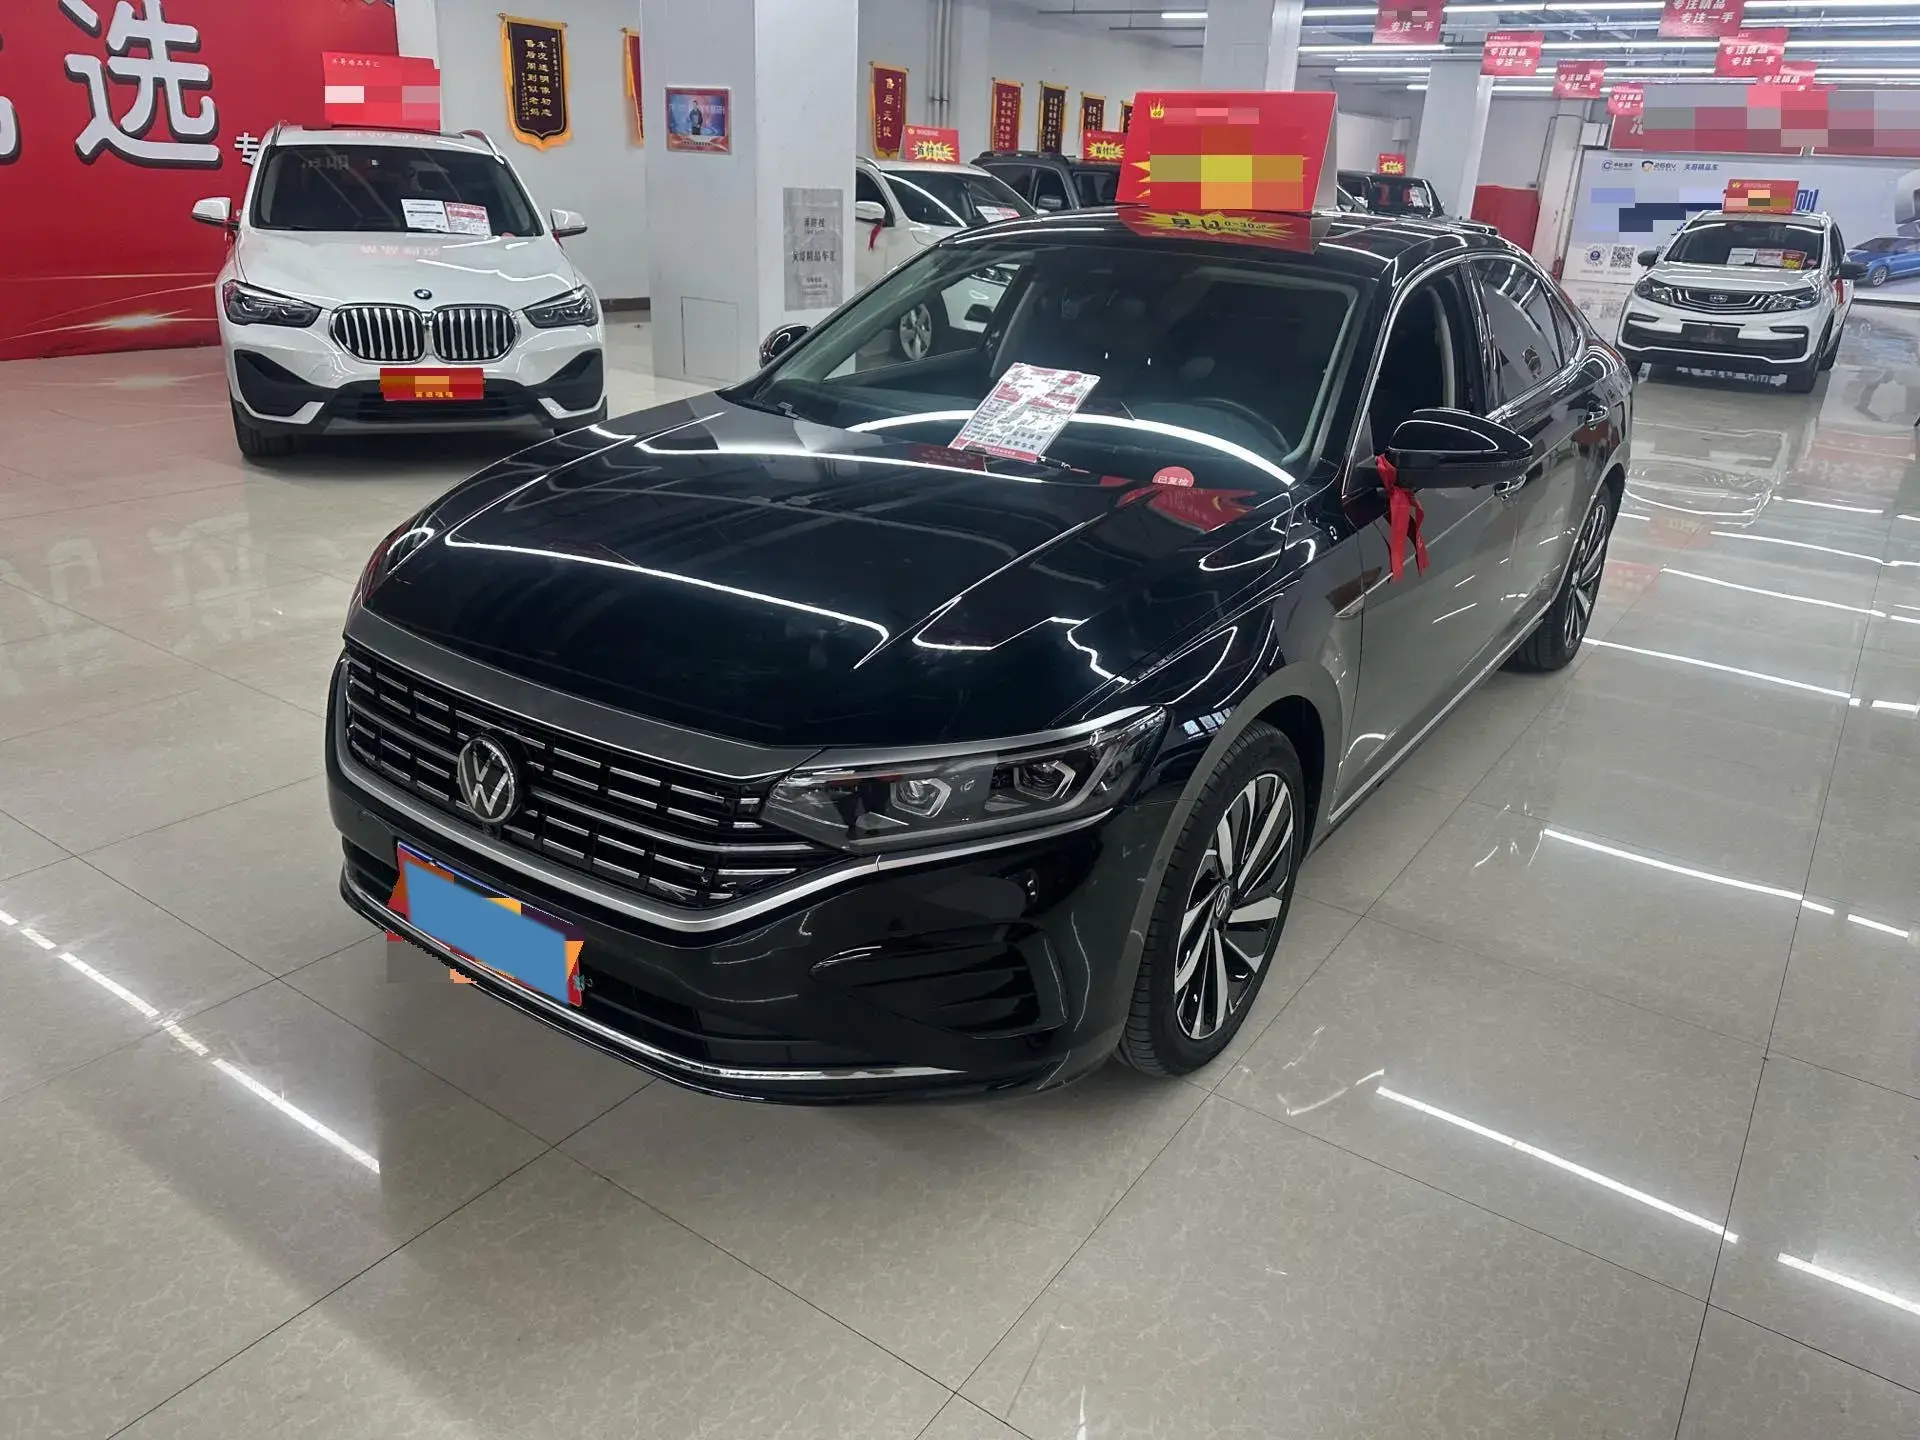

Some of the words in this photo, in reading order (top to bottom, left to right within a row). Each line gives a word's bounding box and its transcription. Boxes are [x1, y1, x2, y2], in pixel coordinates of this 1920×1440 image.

[1681, 12, 1735, 23] 专注一手
[1391, 21, 1434, 32] 专注一手
[0, 0, 222, 170] 选
